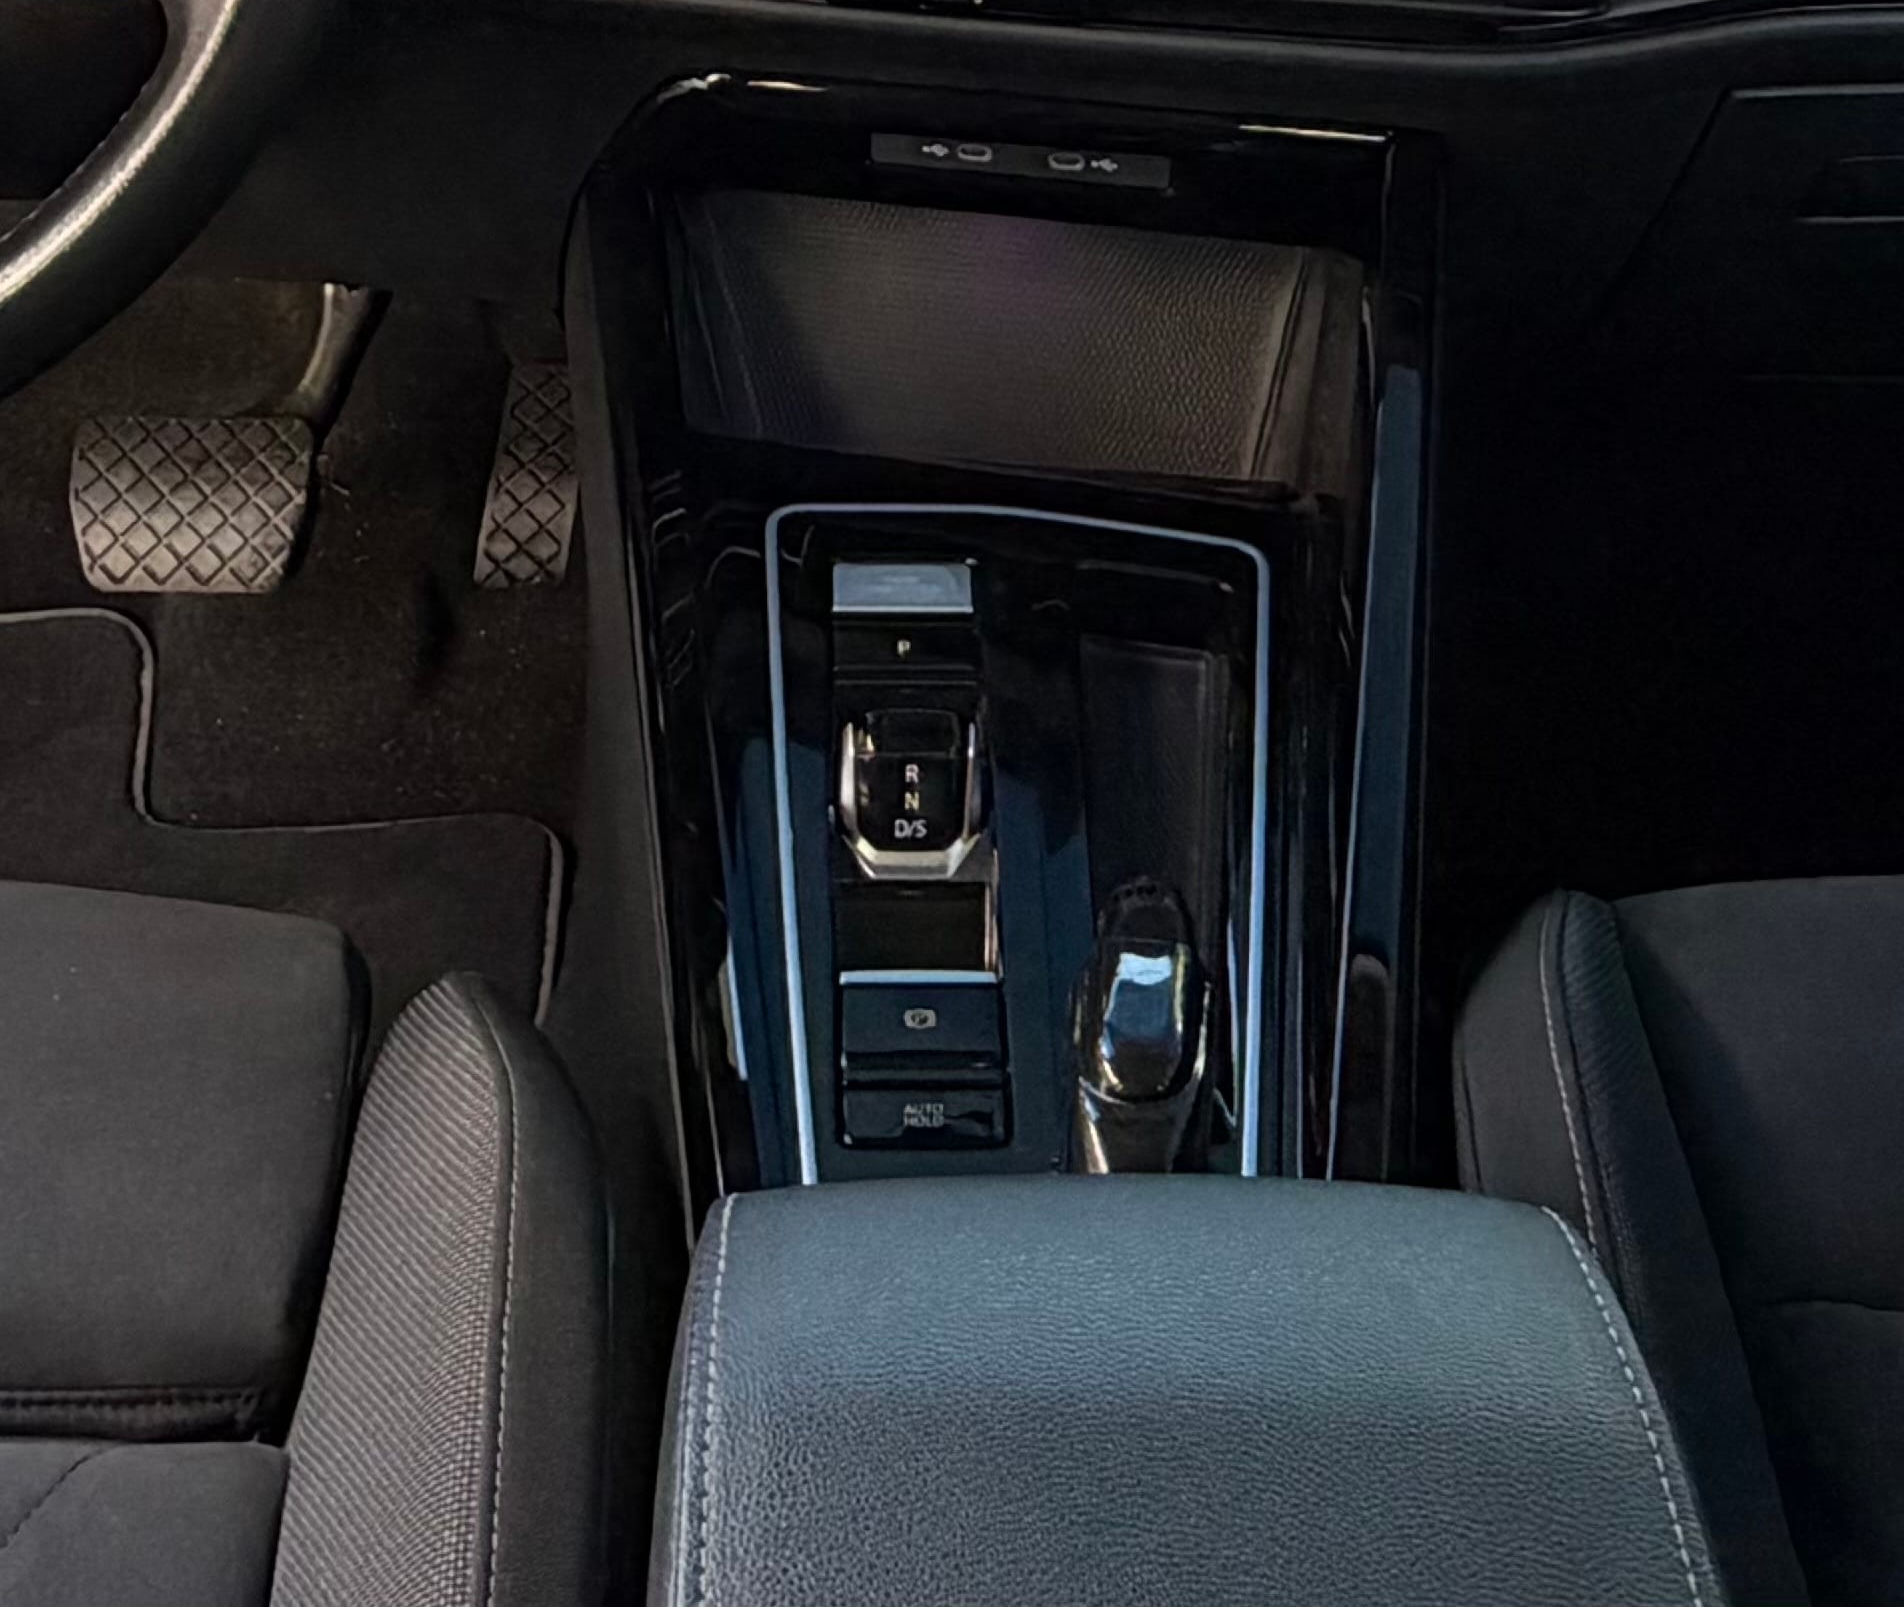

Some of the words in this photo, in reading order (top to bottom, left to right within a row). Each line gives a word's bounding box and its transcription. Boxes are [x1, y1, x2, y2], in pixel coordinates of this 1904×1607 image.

[897, 639, 911, 658] P
[904, 763, 920, 784] R
[904, 791, 920, 811] N
[894, 818, 928, 839] D/S
[903, 1103, 945, 1115] AUTO
[903, 1113, 945, 1128] HOLD
